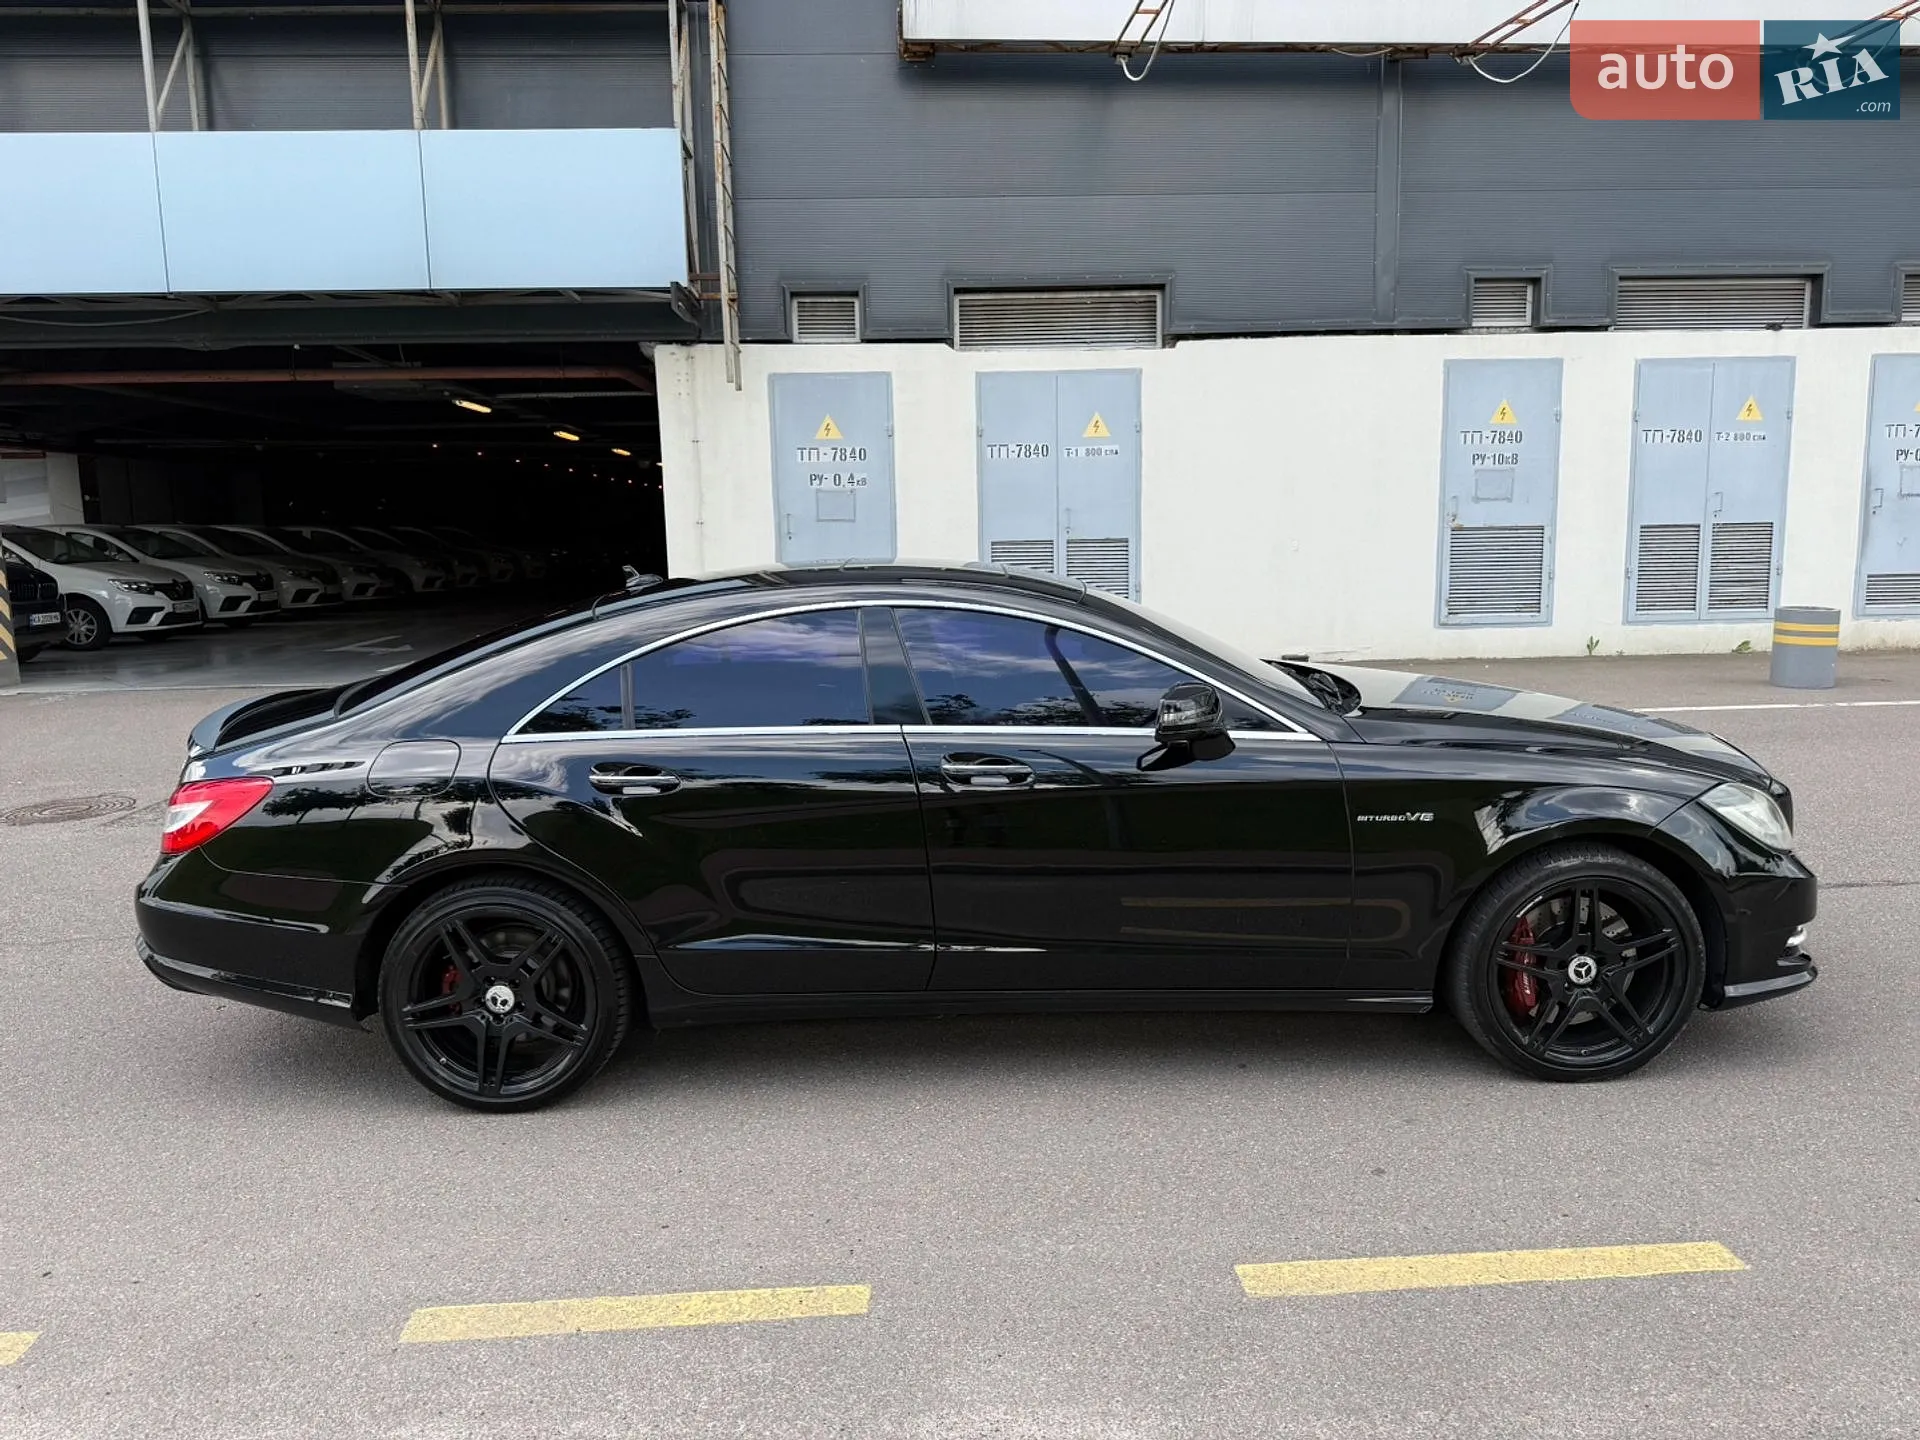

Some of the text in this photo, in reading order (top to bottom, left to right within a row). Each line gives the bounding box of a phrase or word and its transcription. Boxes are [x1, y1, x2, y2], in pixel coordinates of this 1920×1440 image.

[1460, 430, 1523, 444] ТП-7840
[1642, 429, 1703, 443] ТП-7840
[796, 447, 867, 462] ТП-7840
[987, 444, 1049, 459] ТП-7840
